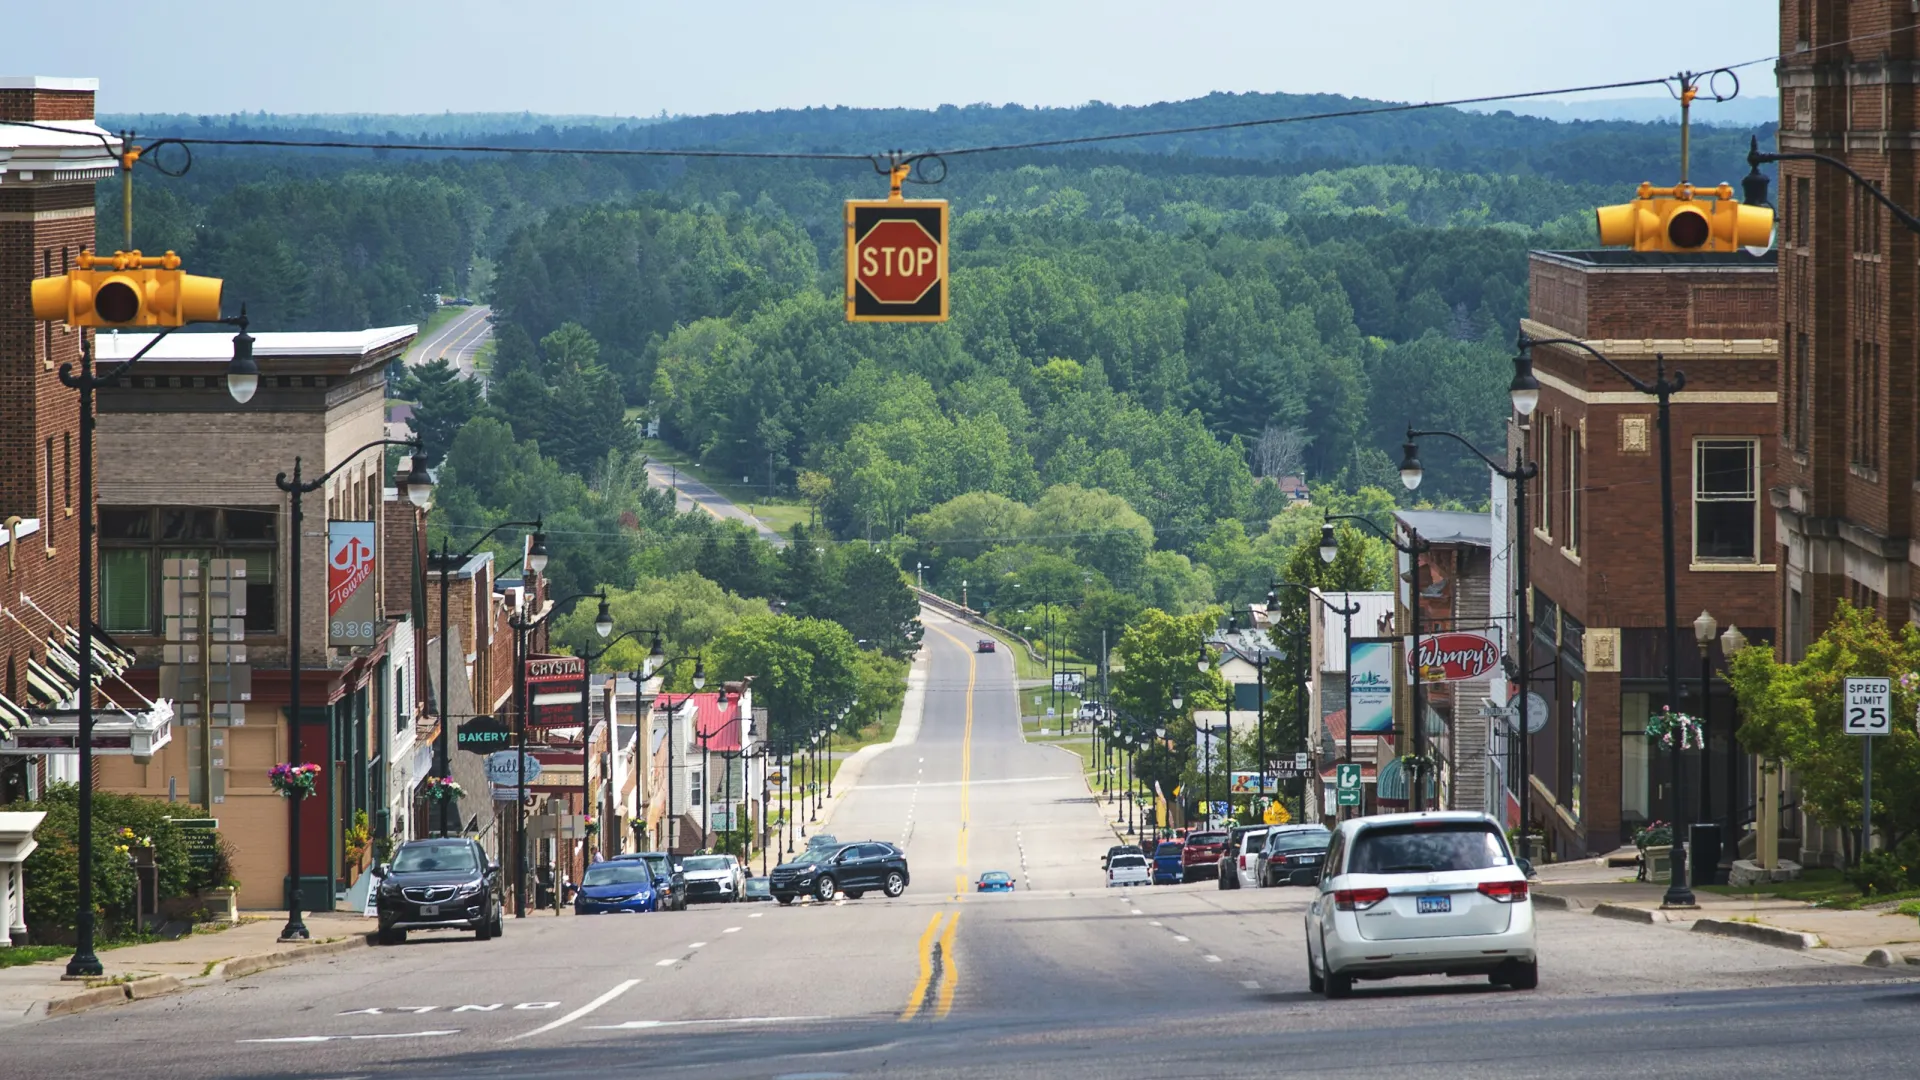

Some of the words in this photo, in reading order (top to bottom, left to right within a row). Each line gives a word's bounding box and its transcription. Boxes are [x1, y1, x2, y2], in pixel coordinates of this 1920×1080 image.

[862, 246, 934, 277] STOP
[331, 541, 374, 570] UP
[330, 563, 371, 603] Towne
[331, 621, 373, 637] 336
[1418, 636, 1494, 676] Wimpy's
[531, 661, 584, 675] CRYSTAL
[1849, 684, 1887, 693] SPEED
[1852, 696, 1882, 705] LIMIT
[1849, 707, 1886, 728] 25
[458, 732, 508, 742] BAKERY
[488, 758, 532, 773] hall!
[1268, 760, 1314, 769] NETTL
[1268, 769, 1314, 777] INSURACE
